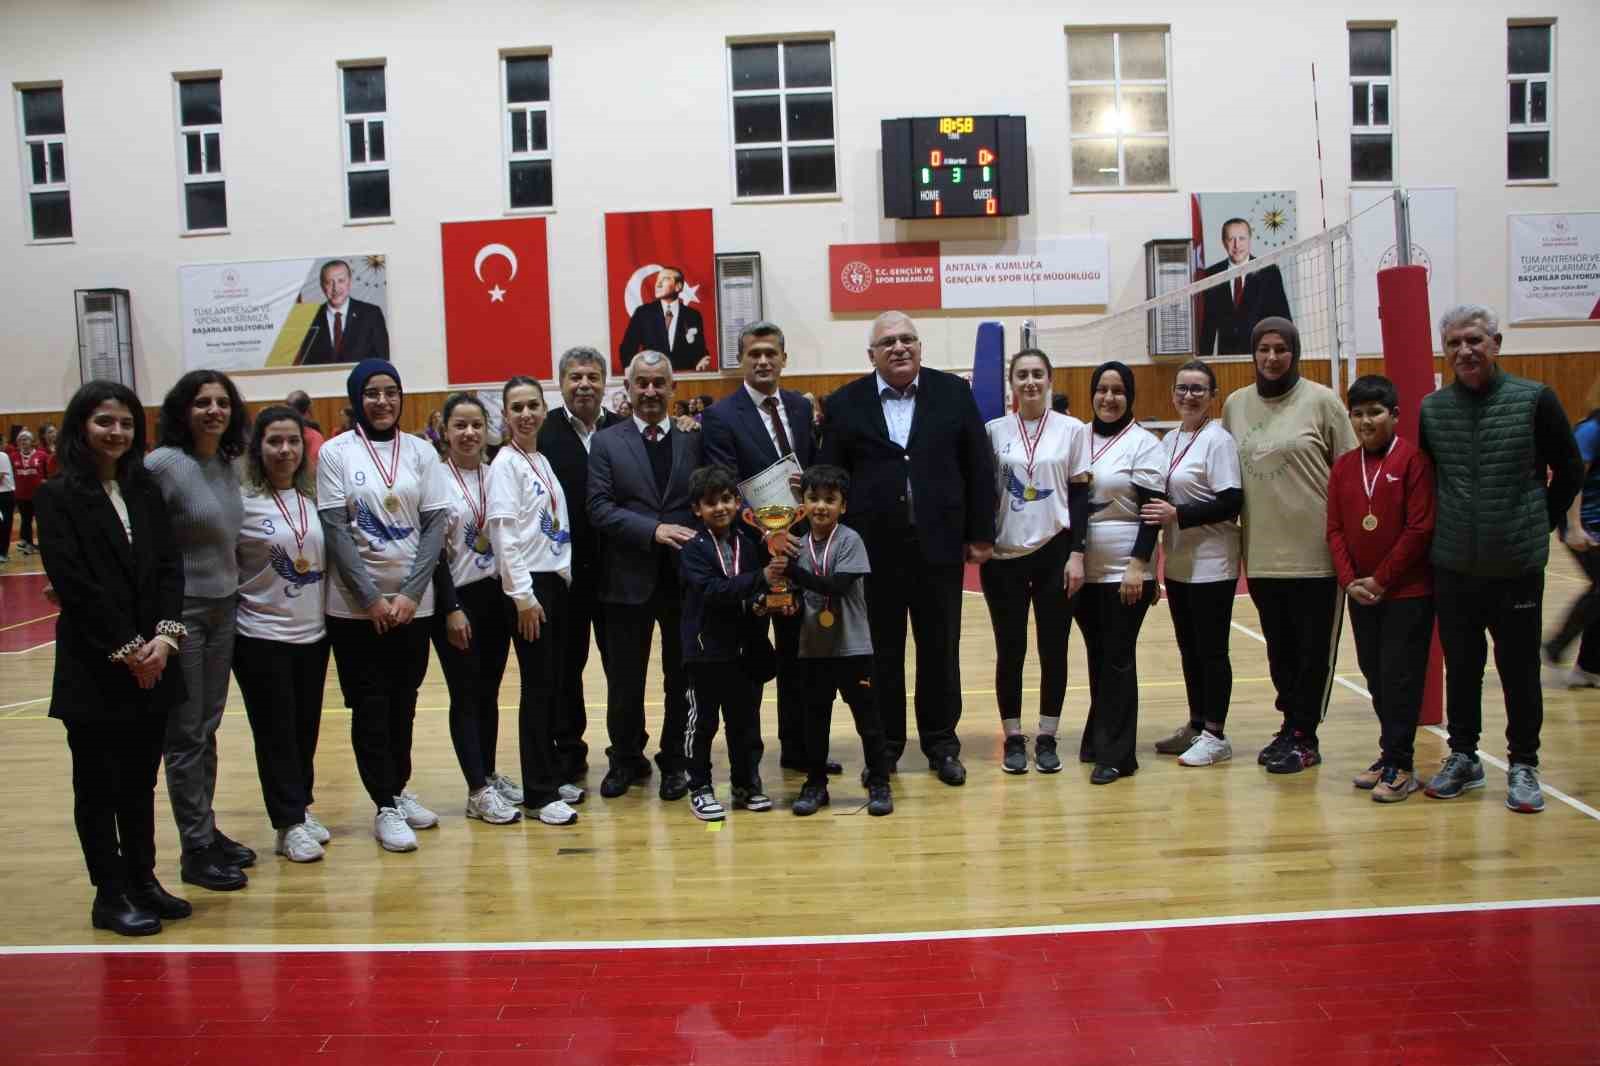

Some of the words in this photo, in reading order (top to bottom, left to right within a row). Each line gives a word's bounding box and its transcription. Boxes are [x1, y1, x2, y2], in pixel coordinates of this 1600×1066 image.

[952, 167, 961, 184] 3
[920, 190, 940, 200] HOME
[973, 188, 993, 200] GUEST
[935, 200, 940, 216] 1
[986, 199, 996, 215] 0
[890, 266, 920, 276] GENÇLİK
[945, 264, 988, 272] ANTALYA
[995, 262, 1042, 270] KUMLUCA
[945, 274, 983, 284] GENÇLİK
[985, 275, 996, 283] VE
[999, 274, 1022, 282] SPOR
[1024, 272, 1041, 283] İLÇE
[1043, 270, 1101, 280] MÜDÜRLÜĞÜ
[354, 471, 366, 486] 9
[533, 480, 545, 496] 2
[262, 519, 276, 536] 3
